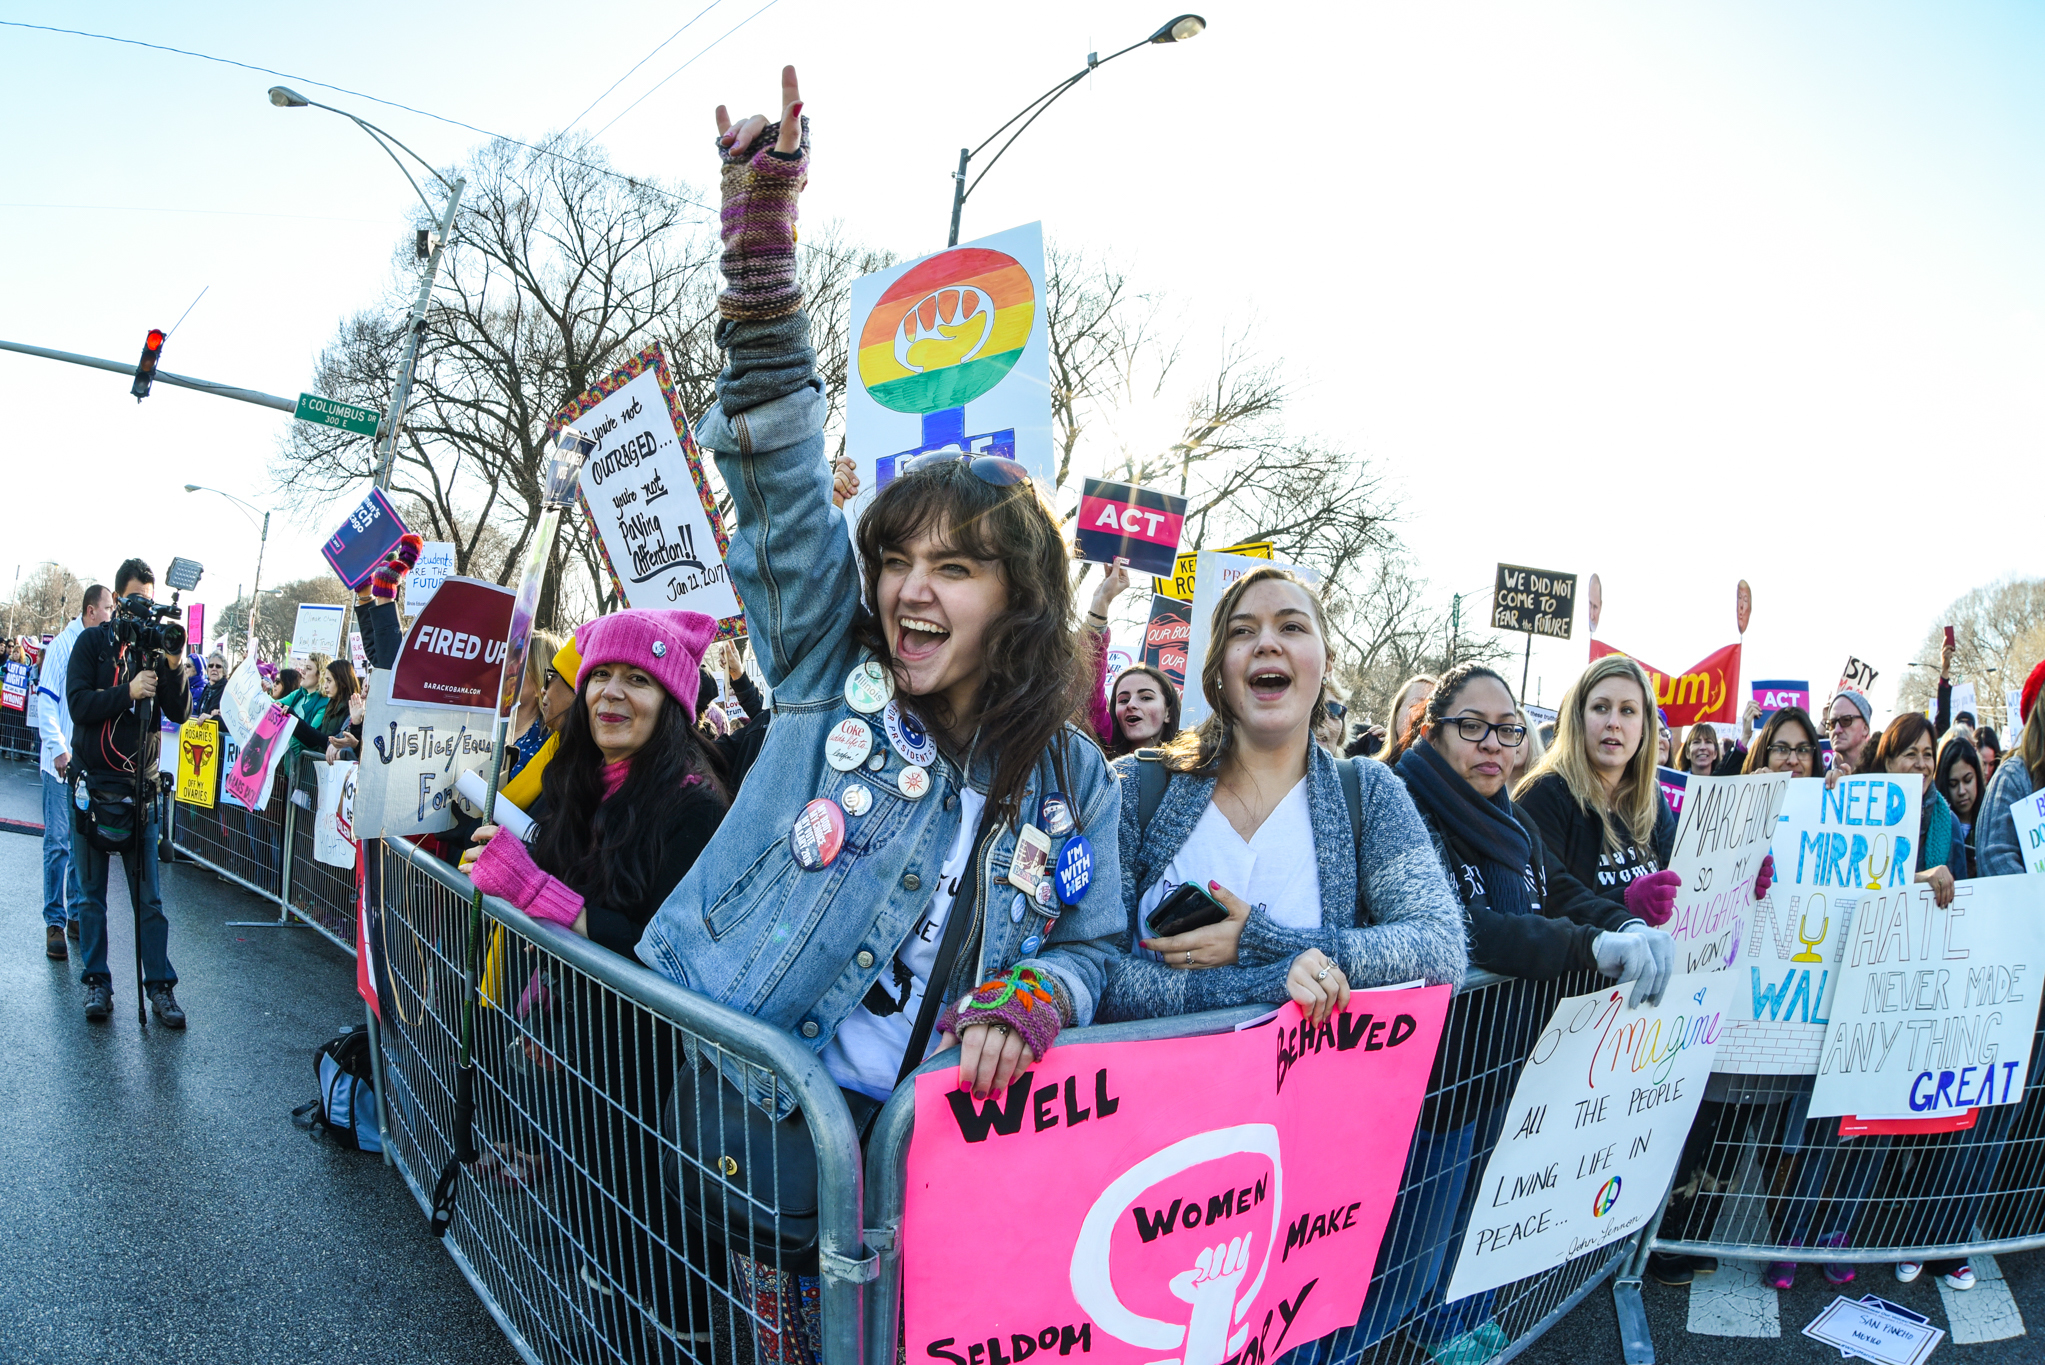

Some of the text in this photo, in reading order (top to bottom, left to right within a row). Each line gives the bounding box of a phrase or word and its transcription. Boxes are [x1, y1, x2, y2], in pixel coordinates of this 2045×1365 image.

[301, 398, 377, 423] S COLUMBUS DR
[324, 415, 348, 428] 300 E
[591, 396, 643, 451] you're not
[612, 467, 665, 521] you're not
[1095, 503, 1165, 537] ACT
[408, 566, 448, 577] ARE THE
[667, 576, 689, 602] Jan
[703, 563, 726, 587] 2017
[1223, 568, 1246, 582] PR
[1503, 568, 1573, 600] WE DID NOT
[1498, 590, 1556, 613] COME TO
[1148, 625, 1191, 641] OUR BOD
[1495, 606, 1570, 639] FEAR the FUTURE
[319, 638, 335, 647] Trump
[413, 624, 482, 660] FIRED
[1161, 654, 1185, 669] OUR
[1844, 657, 1879, 691] STY
[423, 681, 482, 695] BARACKOBAMA.COM
[1763, 691, 1801, 709] ACT
[264, 708, 285, 727] PUSSY
[841, 720, 865, 737] Coke
[887, 704, 898, 722] FOR
[1530, 709, 1556, 721] these truth
[184, 728, 213, 743] ROSARIES
[888, 725, 930, 763] PRESIDENT
[183, 786, 208, 802] OVARIES
[188, 779, 196, 788] OFF
[817, 803, 833, 836] MY BODY
[1673, 780, 1789, 858] MARCHING
[1820, 780, 1907, 827] NEED
[793, 820, 813, 867] HILLARY 2016
[800, 814, 816, 847] MY VOTE
[808, 808, 827, 848] MY CHOICE
[1059, 854, 1091, 885] WITH
[1066, 842, 1084, 865] I'M
[1013, 865, 1041, 887] BOSTON
[1065, 870, 1090, 898] HER
[1693, 852, 1751, 892] SO MY
[1851, 885, 1974, 968] HATE
[1687, 930, 1731, 975] WONT
[1862, 963, 2027, 1014] NEVER MADE
[1276, 1012, 1417, 1096] BEHAVED
[1588, 990, 1722, 1089] Imagine
[1821, 1012, 2002, 1076] ANYTHING
[1573, 1094, 1611, 1130] THE
[1627, 1077, 1686, 1117] PEOPLE
[1908, 1061, 2020, 1113] GREAT
[943, 1068, 1120, 1143] WELL
[1492, 1128, 1652, 1208] LIVING LIFE IN
[1132, 1172, 1269, 1244] WOMEN
[1281, 1201, 1362, 1264] MAKE
[1565, 1214, 1643, 1261] John Lennon
[926, 1322, 1092, 1365] SELDOM
[1852, 1330, 1882, 1346] MEXICO
[1860, 1314, 1881, 1329] SAN
[1882, 1323, 1914, 1341] PANCHO
